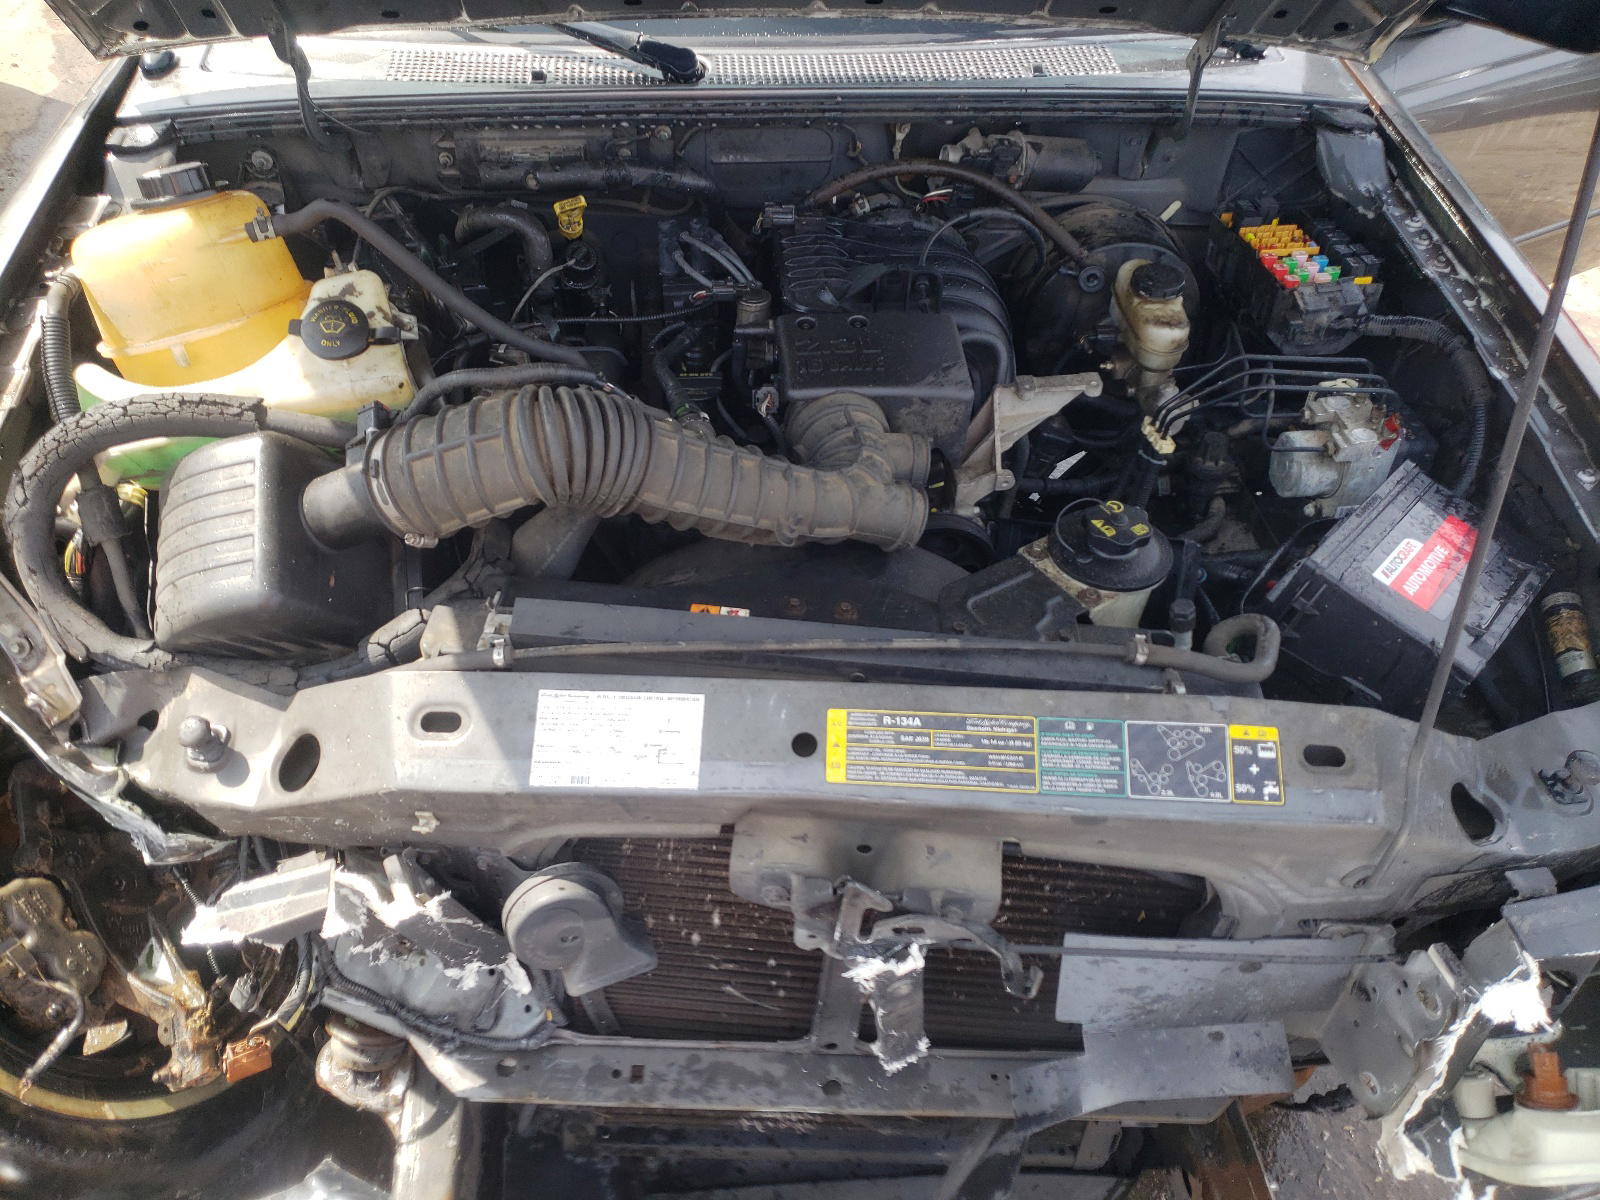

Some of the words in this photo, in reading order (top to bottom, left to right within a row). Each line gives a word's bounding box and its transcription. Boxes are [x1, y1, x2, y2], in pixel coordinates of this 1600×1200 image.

[320, 339, 341, 348] ONLY
[1384, 540, 1417, 576] AUTOCRAFT
[1402, 545, 1448, 596] AUTOMOTIVE
[882, 715, 922, 727] R-134A
[1232, 744, 1253, 756] 50%
[1234, 783, 1256, 795] 50%
